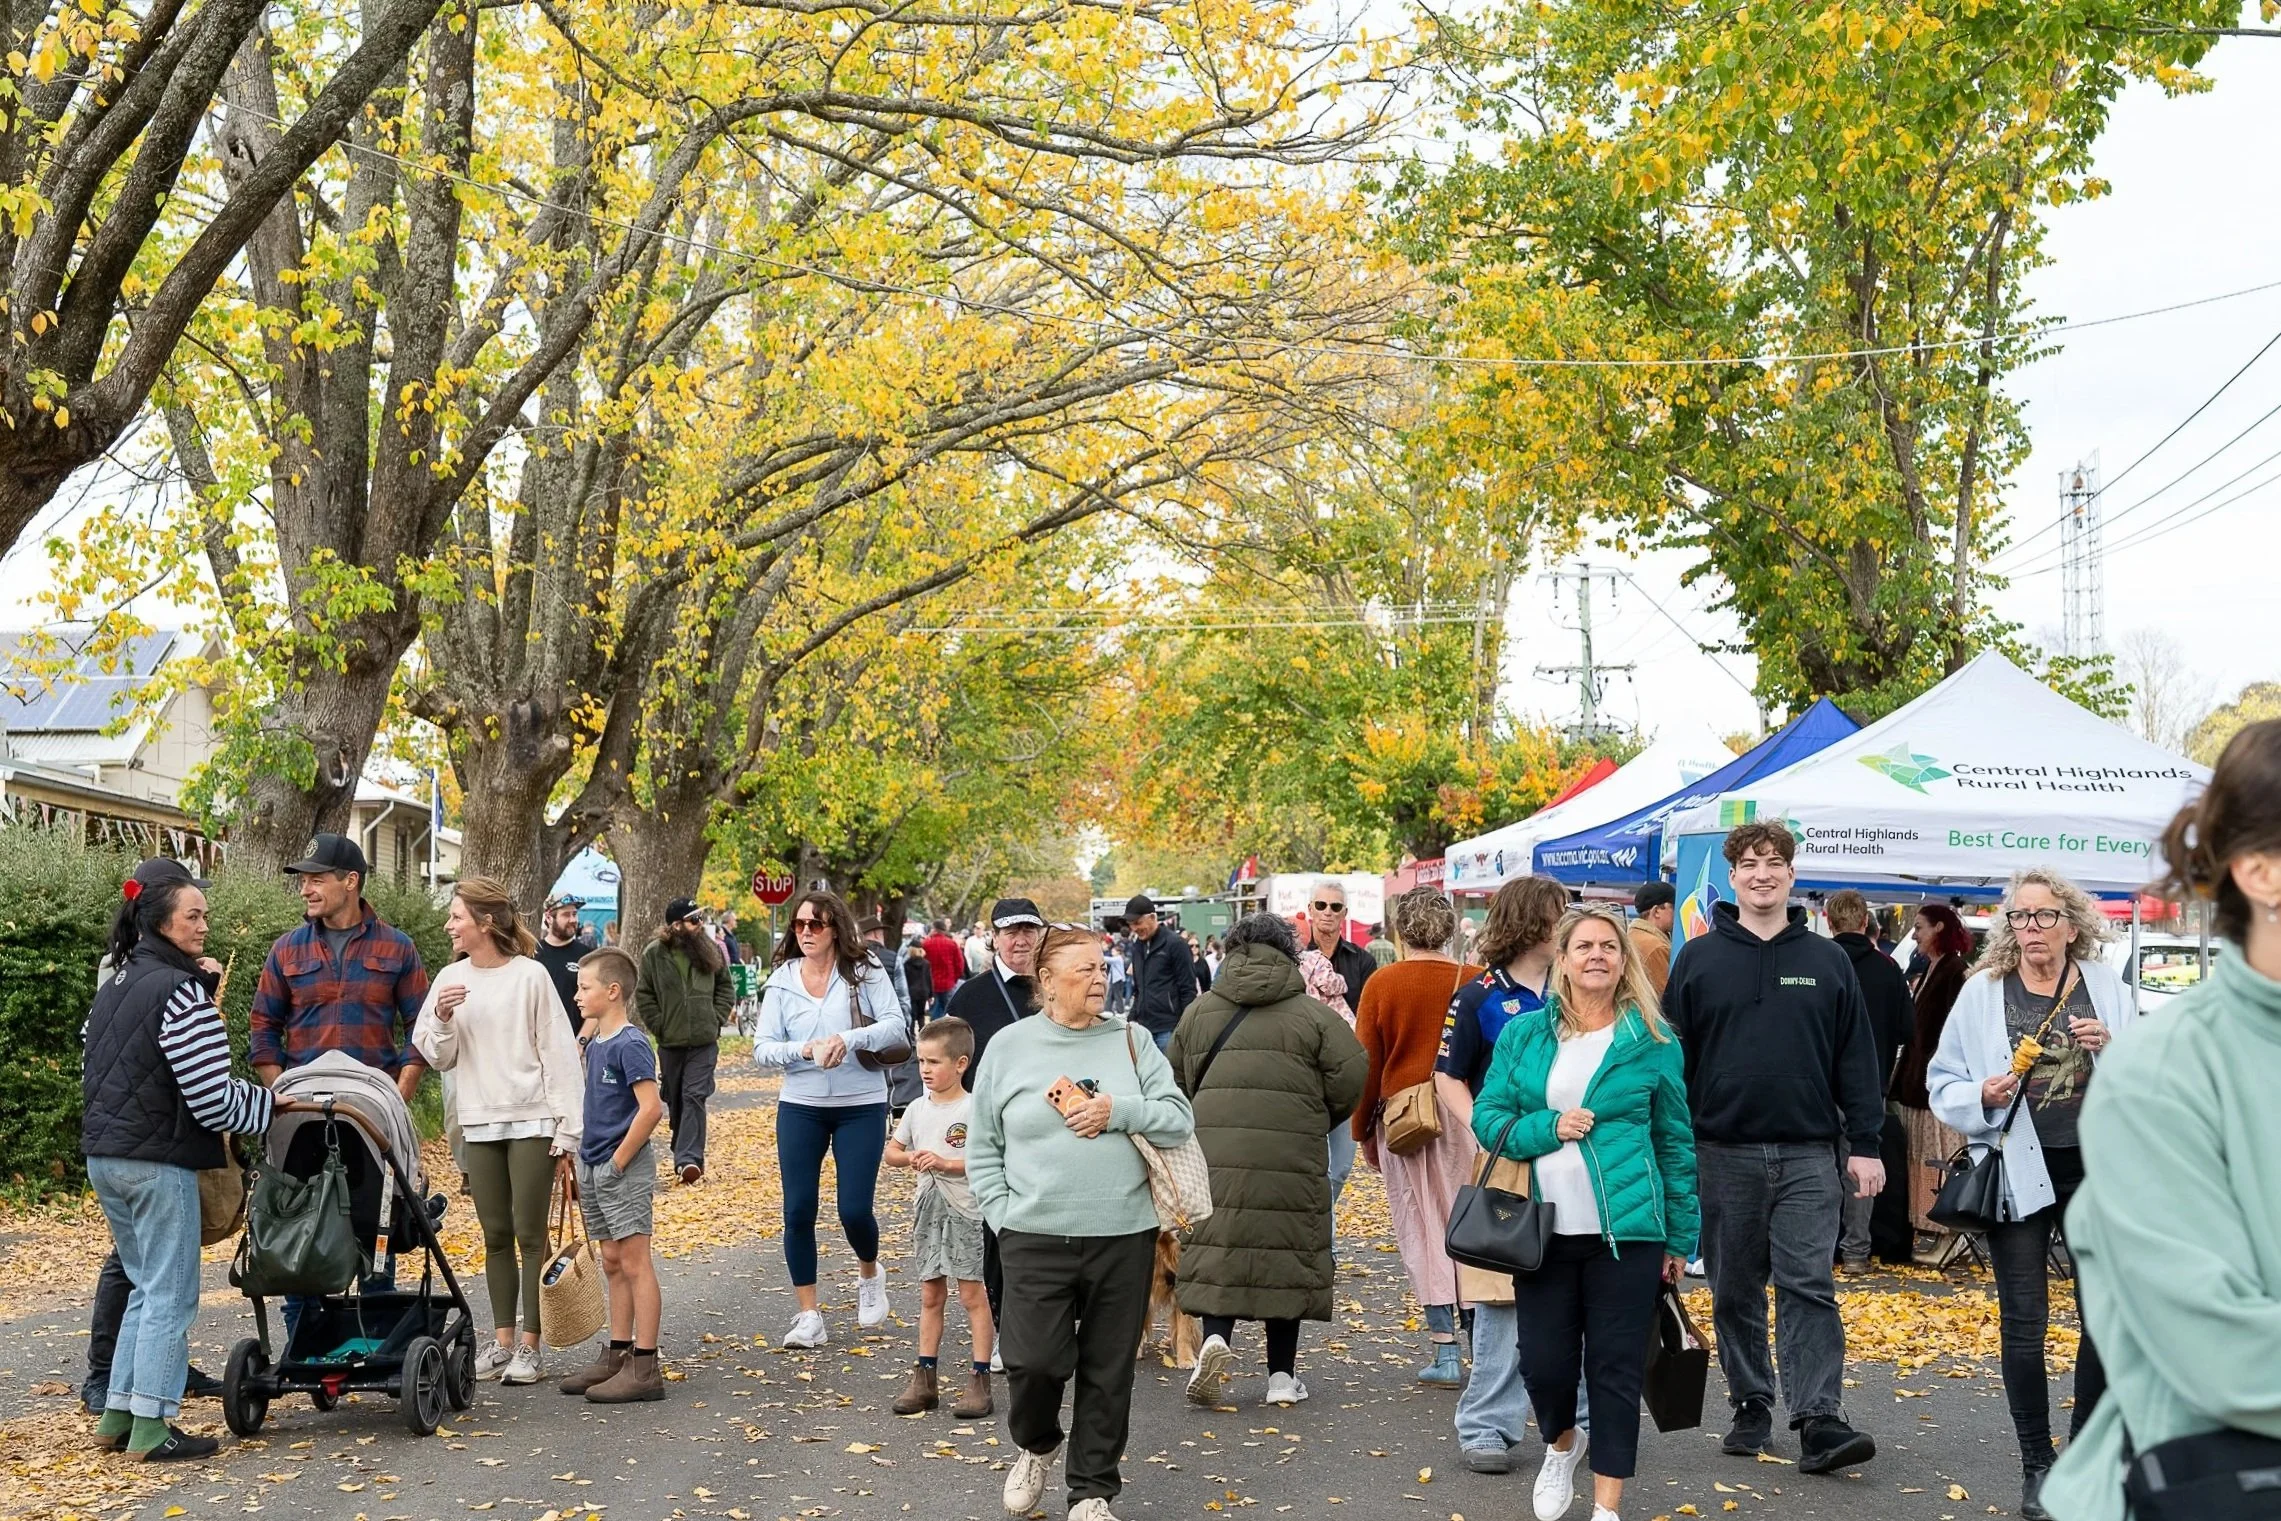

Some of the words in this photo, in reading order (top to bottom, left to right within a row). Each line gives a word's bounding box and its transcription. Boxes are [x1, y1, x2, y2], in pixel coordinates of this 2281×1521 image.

[1953, 763, 2048, 777] Central
[2056, 767, 2192, 780] Highlands
[1957, 778, 2027, 790] Rural
[2036, 781, 2125, 792] Health
[1806, 827, 1851, 839] Central
[1855, 828, 1919, 841] Highlands
[1805, 842, 1839, 854] Rural
[1843, 843, 1884, 855] Health
[1949, 830, 1994, 848] Best
[2001, 832, 2051, 849] Care
[2058, 833, 2088, 850] for
[2096, 836, 2153, 858] Every
[755, 875, 792, 892] STOP
